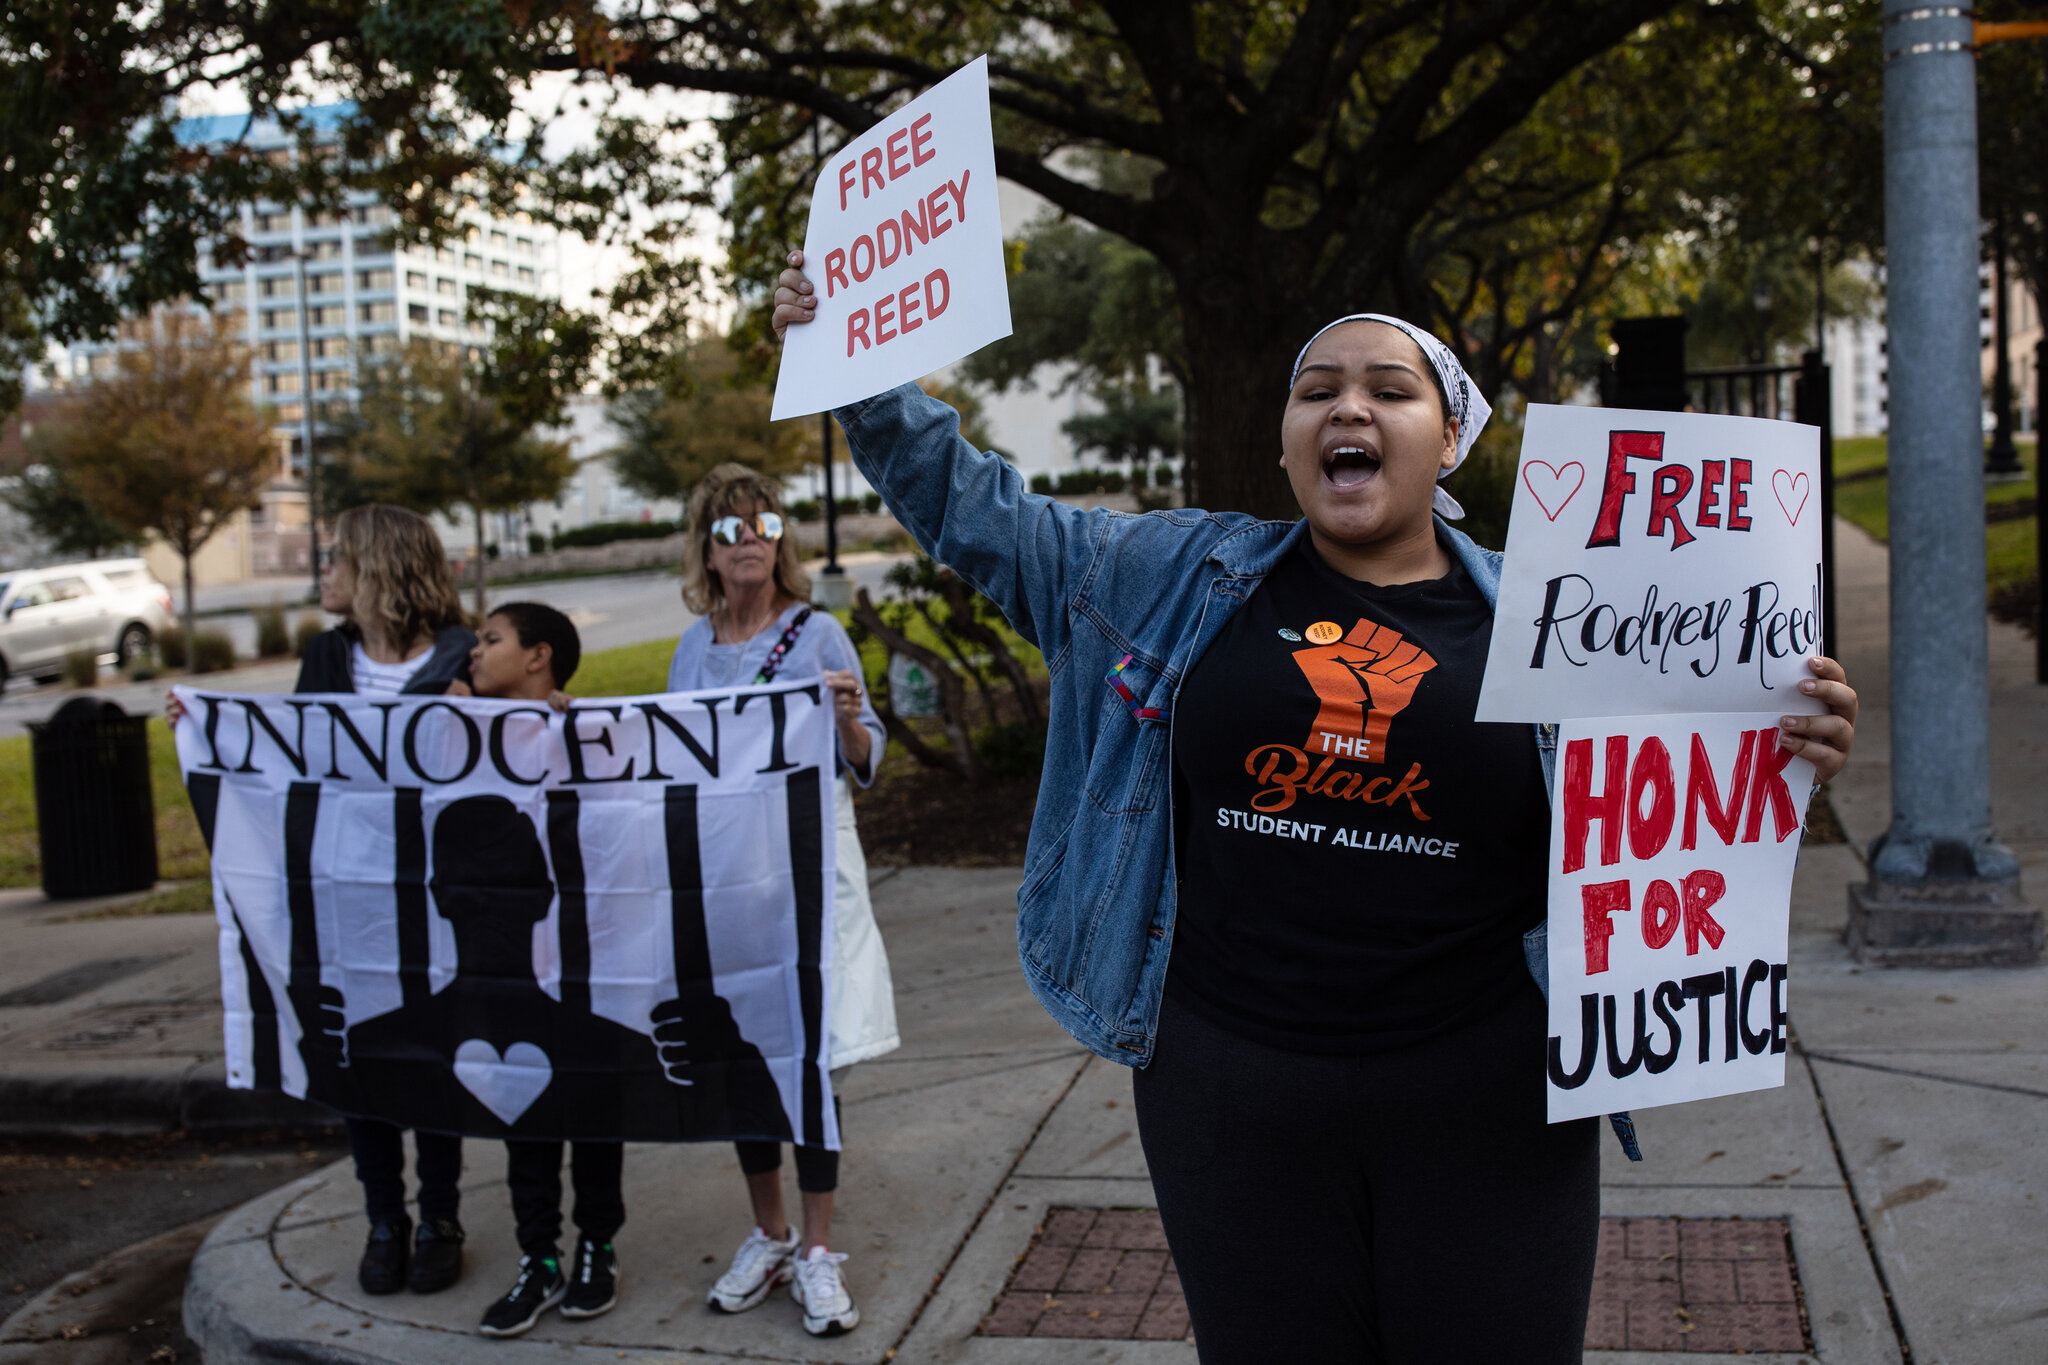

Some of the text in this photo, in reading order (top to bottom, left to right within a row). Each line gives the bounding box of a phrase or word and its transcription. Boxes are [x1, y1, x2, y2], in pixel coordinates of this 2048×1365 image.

[839, 112, 936, 211] FREE
[824, 169, 971, 298] RODNEY
[847, 268, 950, 358] REED
[1585, 430, 1753, 551] FREE
[1529, 574, 1731, 677] Rodney
[196, 684, 821, 786] INNOCENT
[1245, 744, 1432, 822] Black
[1319, 731, 1371, 759] THE
[1216, 807, 1460, 858] STUDENT ALLIANCE
[1563, 727, 1799, 875] HONK
[1582, 869, 1726, 976] FOR
[1548, 959, 1787, 1090] JUSTICE
